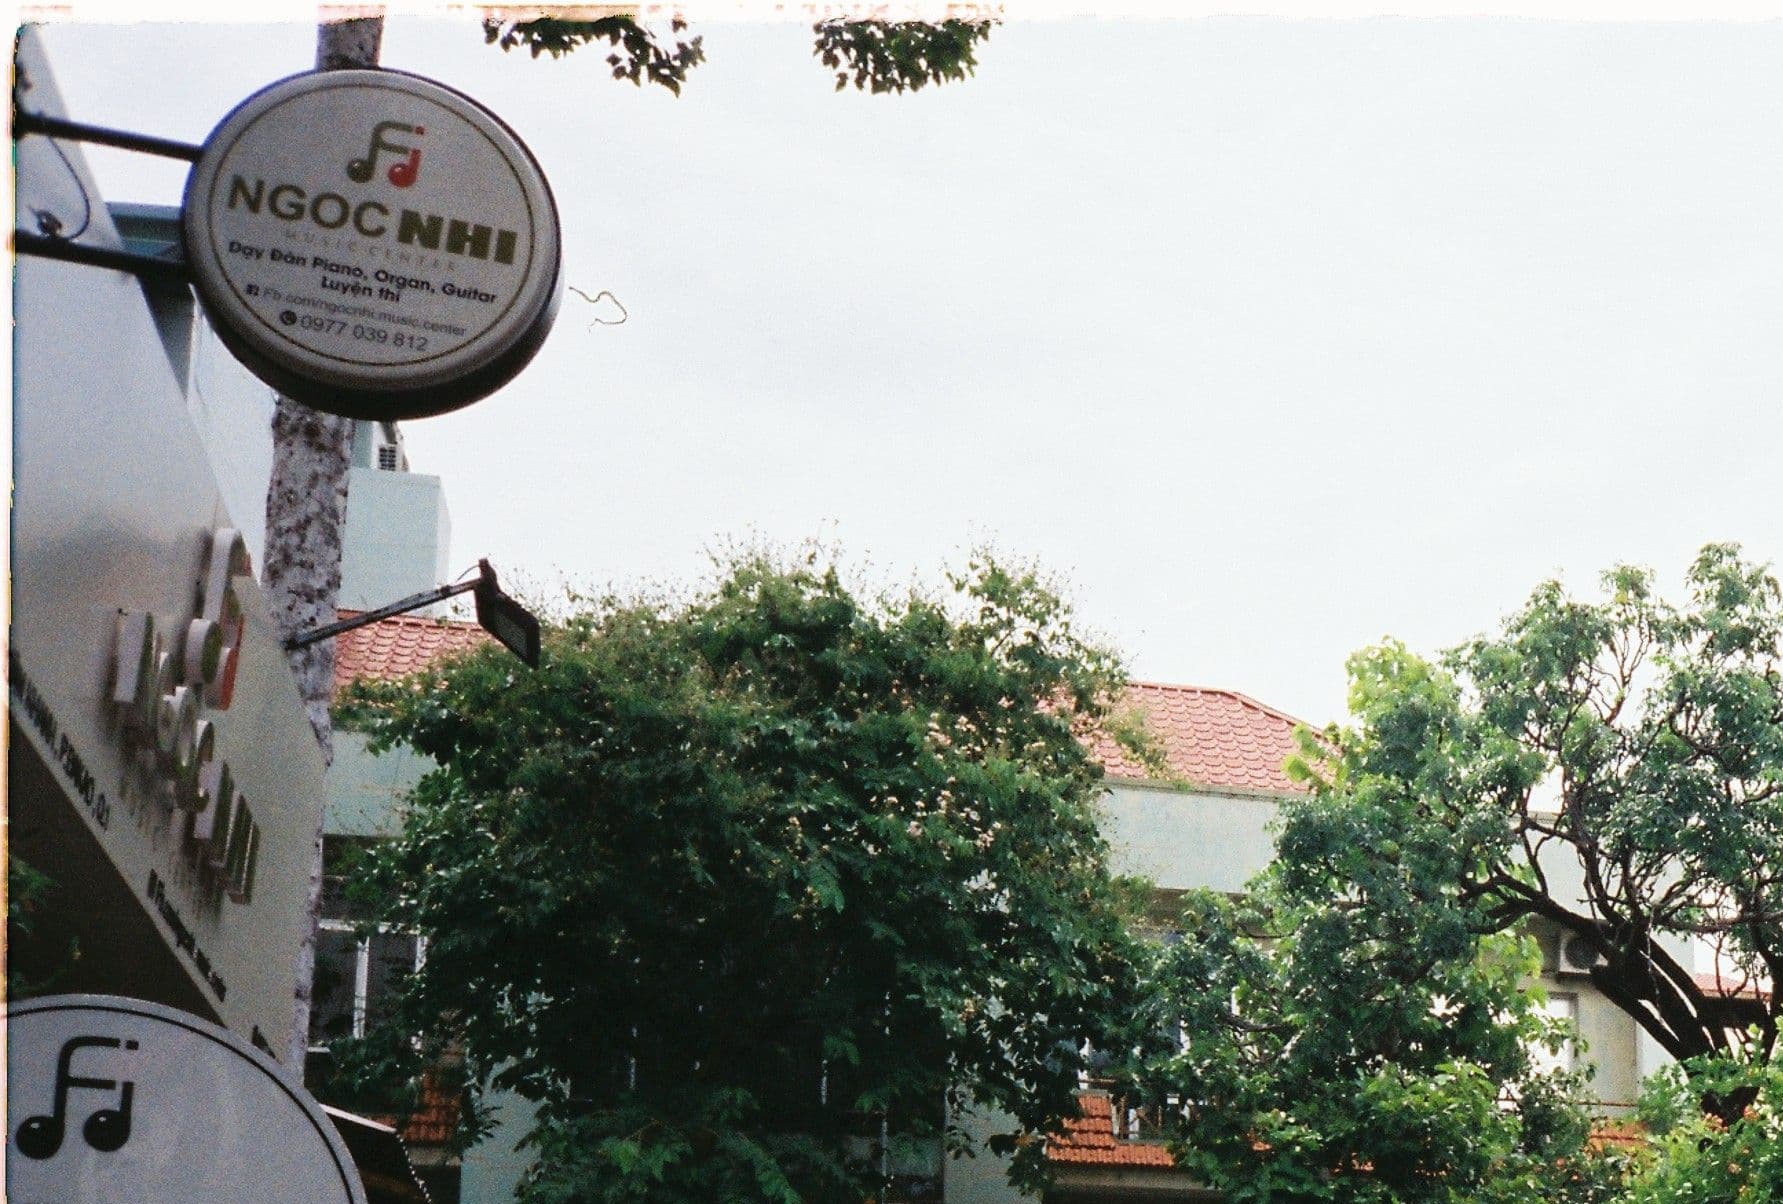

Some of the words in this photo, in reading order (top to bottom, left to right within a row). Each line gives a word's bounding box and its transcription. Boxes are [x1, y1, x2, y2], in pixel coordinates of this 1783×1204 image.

[396, 209, 518, 266] NHI
[229, 241, 264, 260] Dạy
[312, 257, 368, 280] Piano,
[374, 269, 435, 293] Organ,
[442, 283, 497, 304] Guitar
[320, 276, 372, 298] Luyện
[379, 287, 401, 303] thi
[300, 314, 348, 335] 0977
[353, 325, 387, 344] 039
[393, 332, 429, 351] 812
